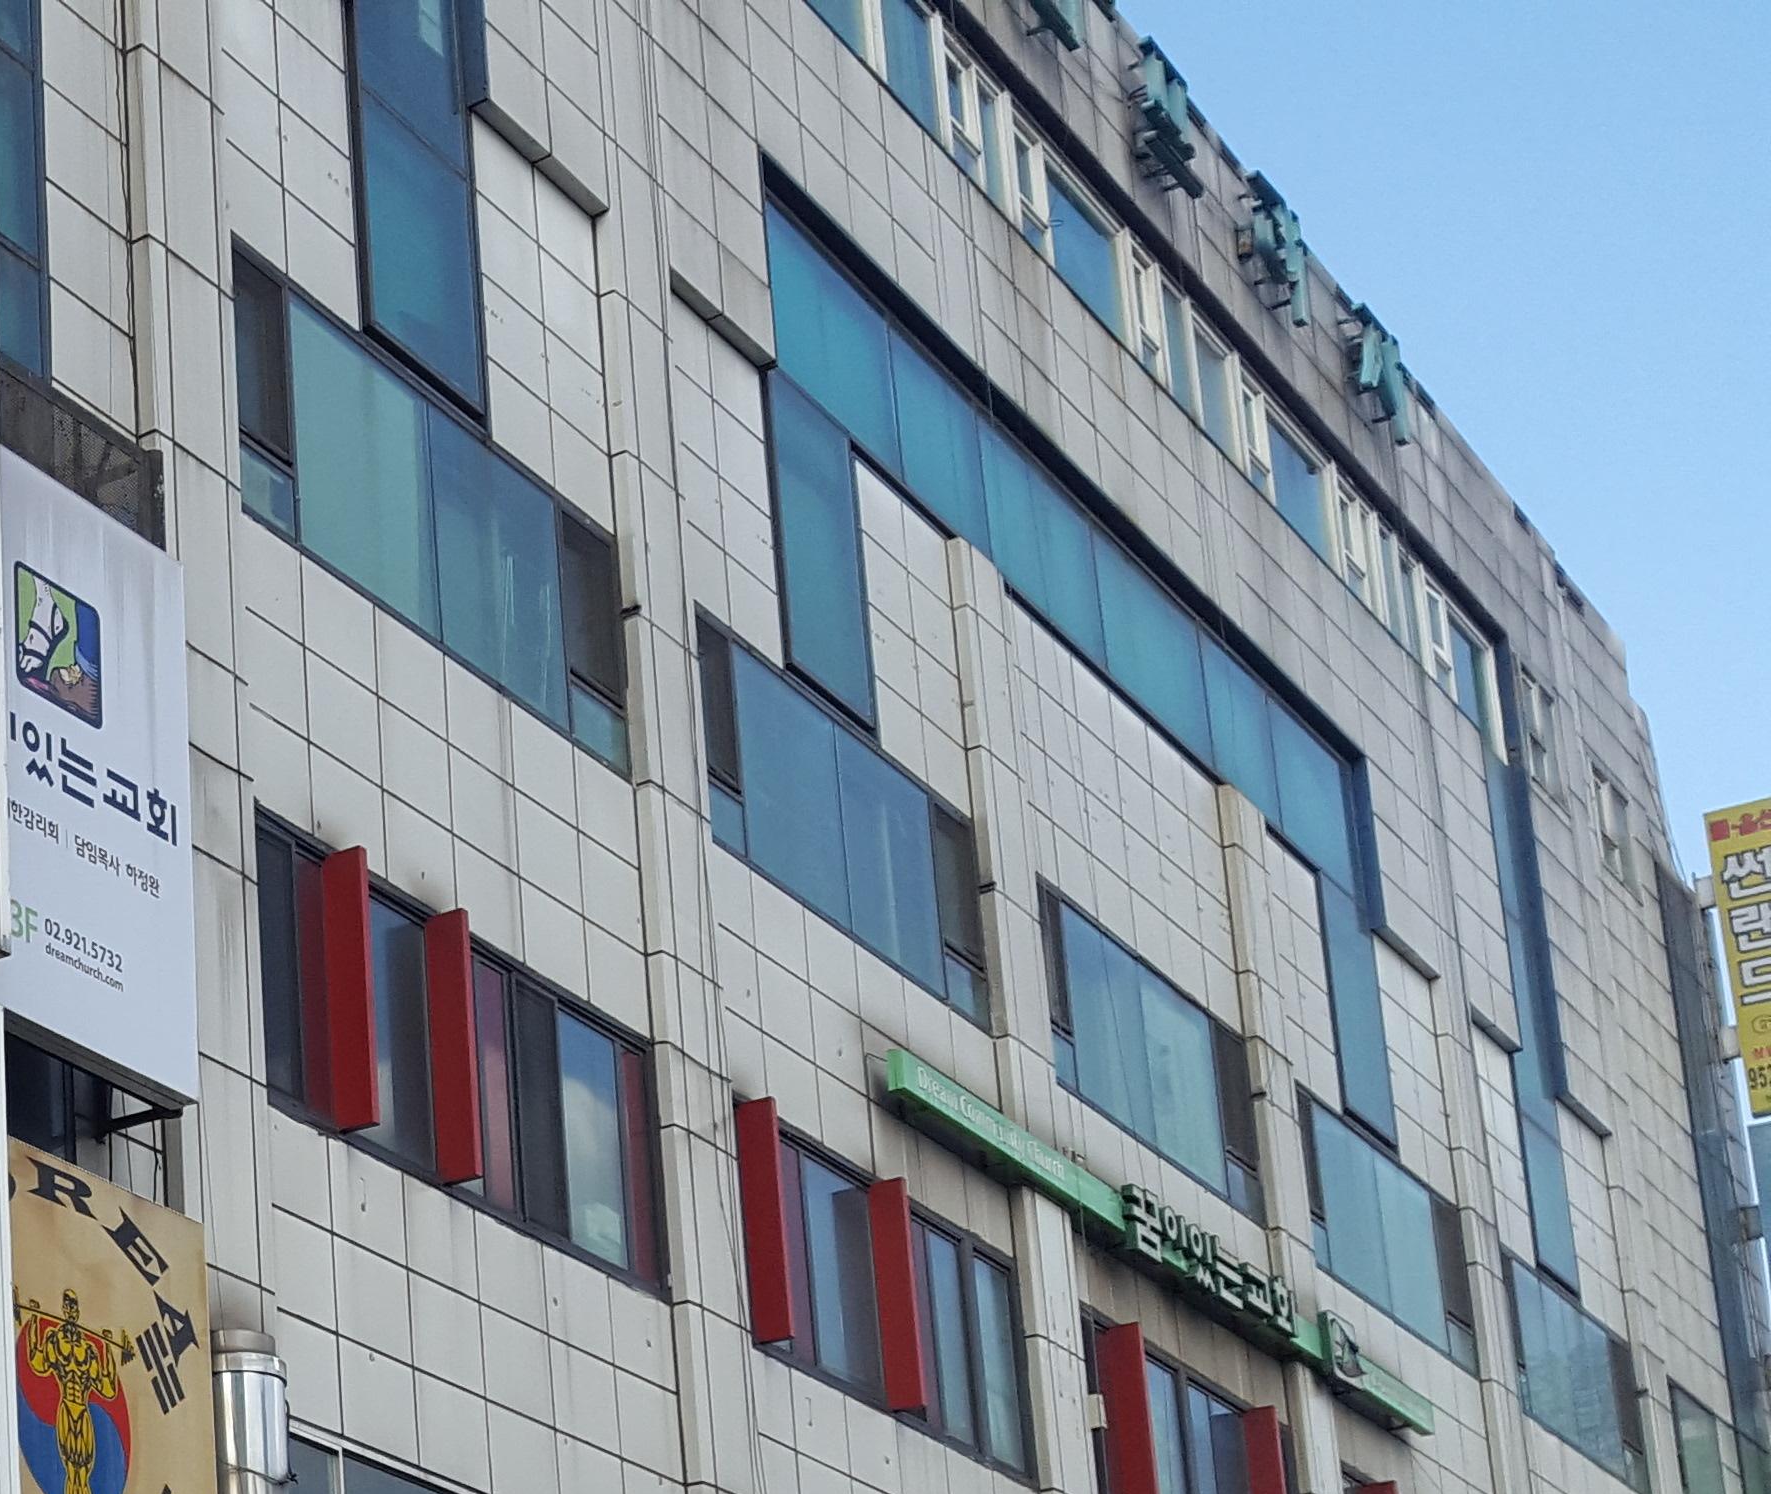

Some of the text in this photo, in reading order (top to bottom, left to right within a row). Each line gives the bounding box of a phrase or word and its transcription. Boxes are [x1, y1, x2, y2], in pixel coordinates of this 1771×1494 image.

[8, 797, 60, 844] 한감리회
[74, 834, 120, 876] 담임목사
[44, 918, 123, 973] 02.921.5732
[45, 943, 124, 992] dreamchurch.com
[1122, 1183, 1300, 1338] 꿈이있는교회
